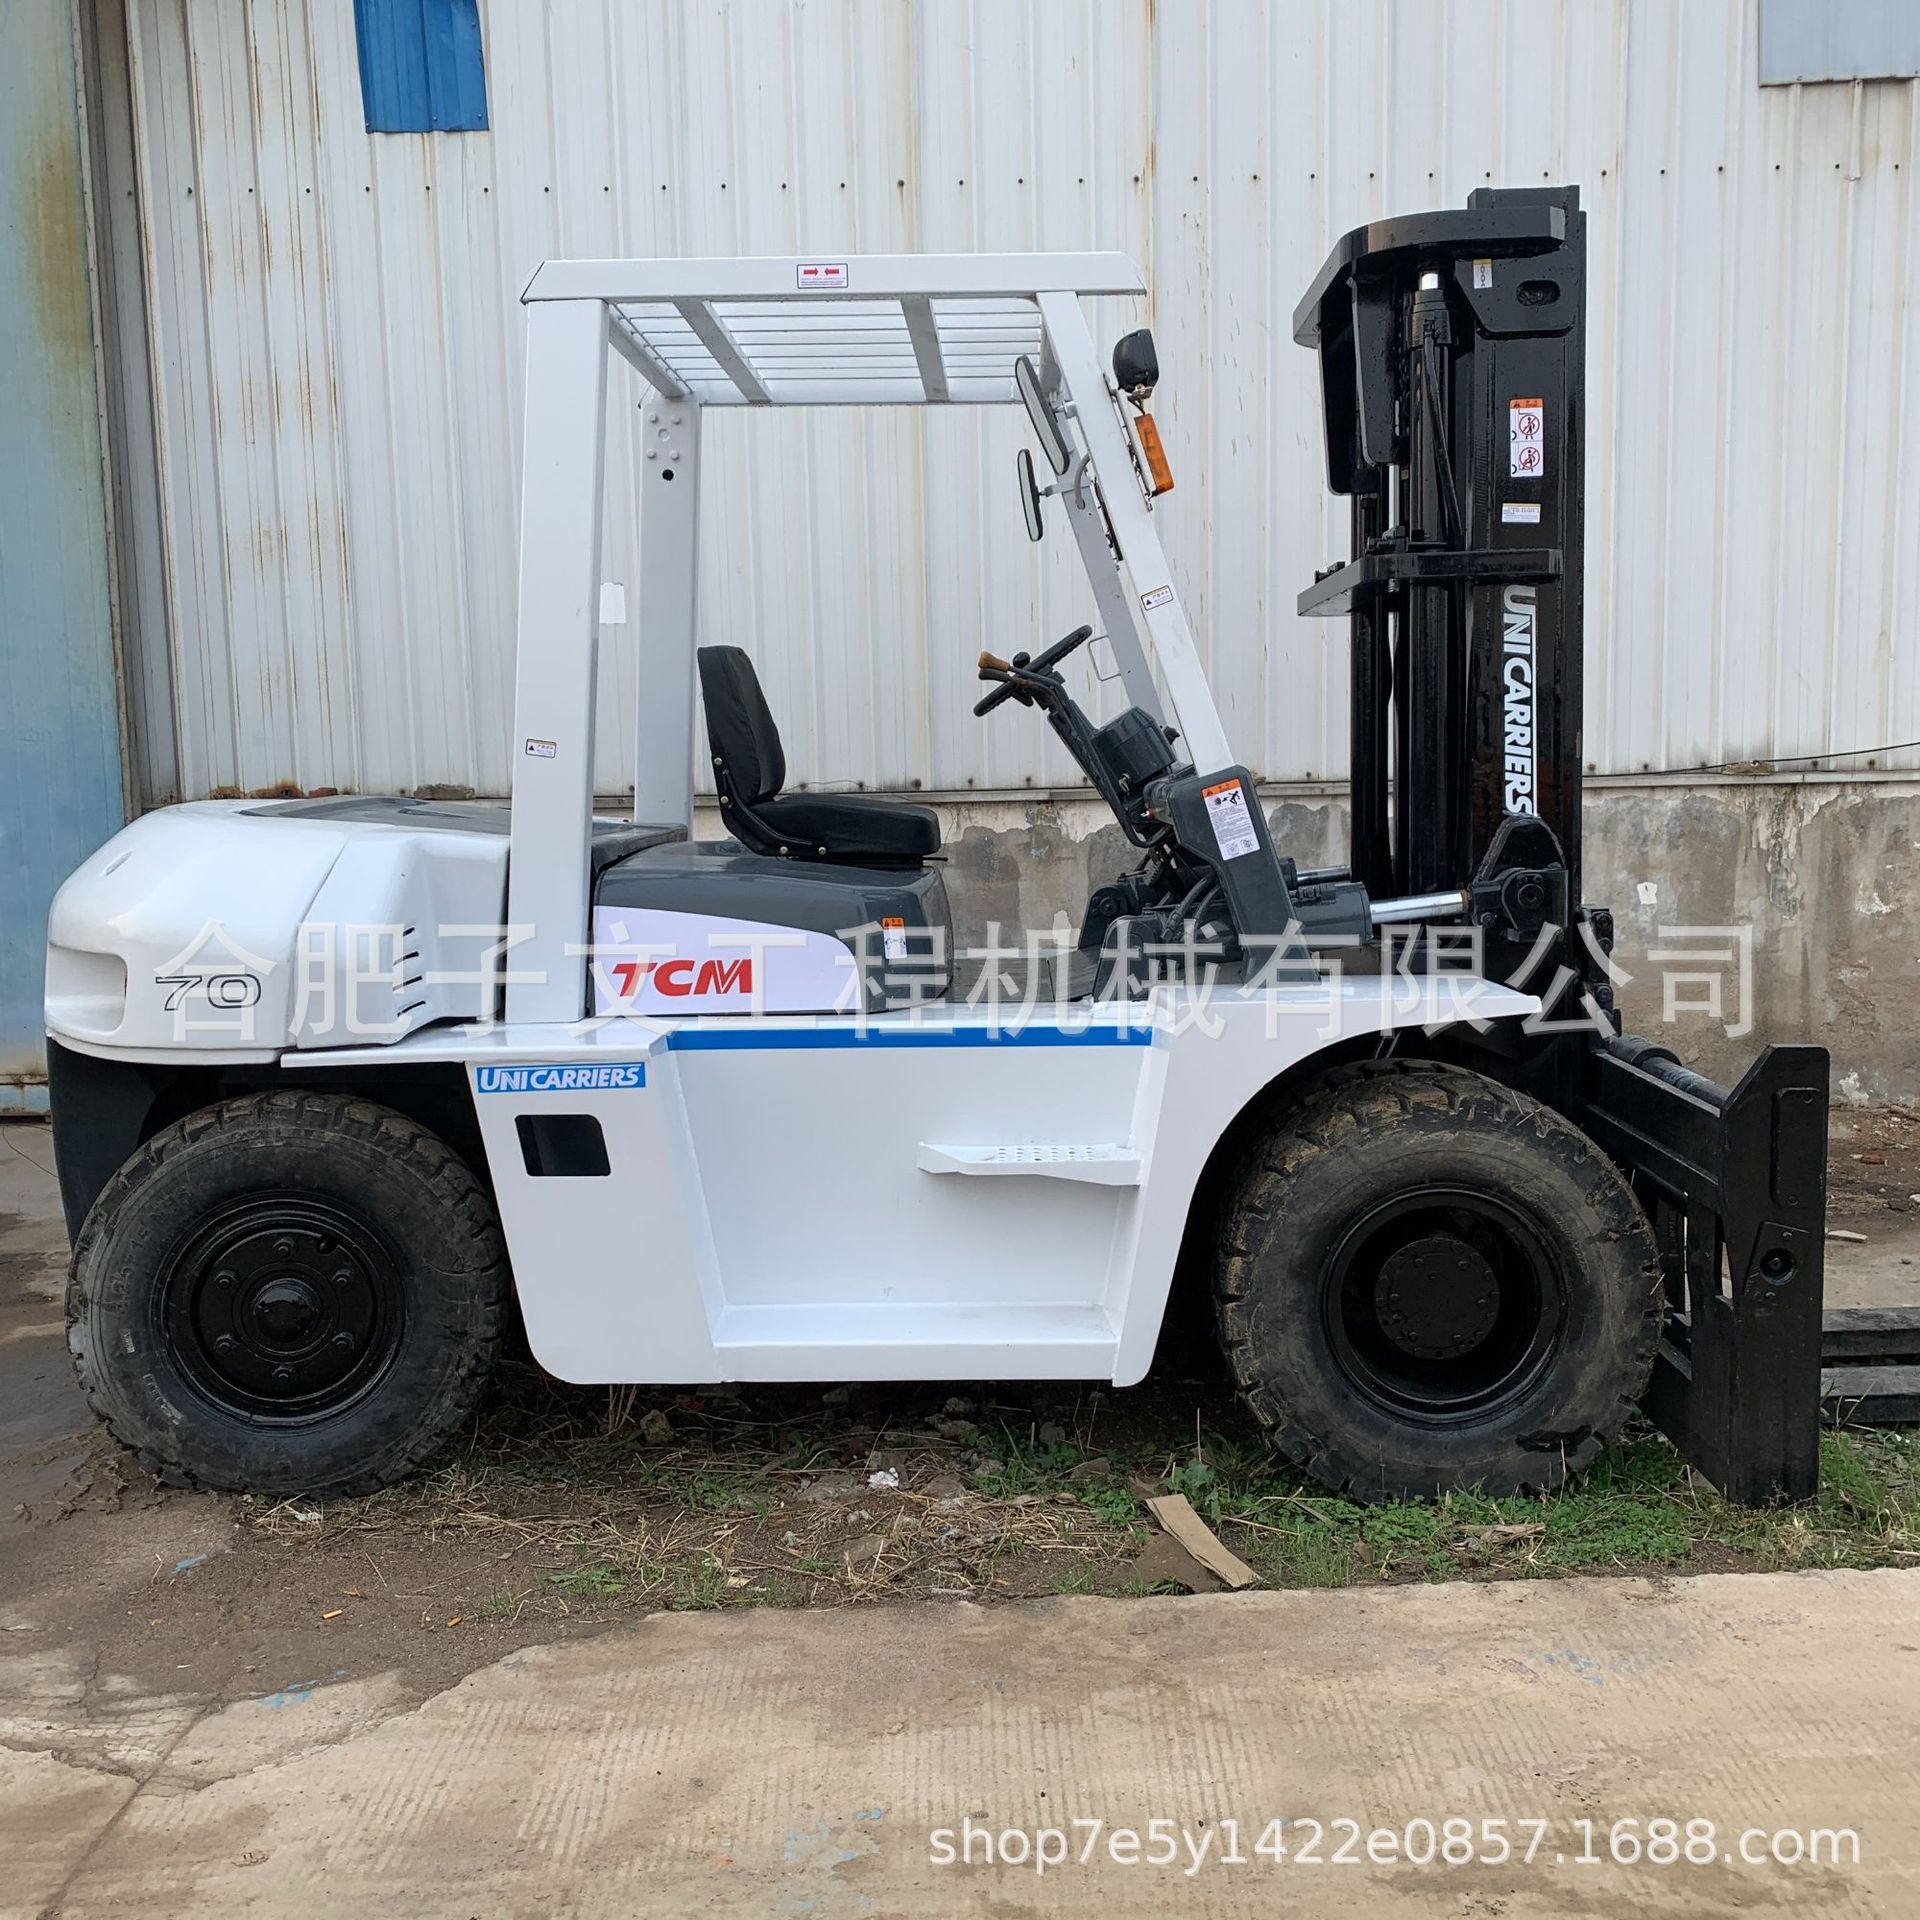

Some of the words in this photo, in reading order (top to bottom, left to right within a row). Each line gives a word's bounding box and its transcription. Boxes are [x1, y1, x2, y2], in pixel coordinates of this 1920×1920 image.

[1503, 584, 1537, 817] UNICARRIERS
[155, 973, 261, 1011] 70
[611, 959, 754, 998] TCM
[479, 1063, 642, 1091] UNICARRIERS
